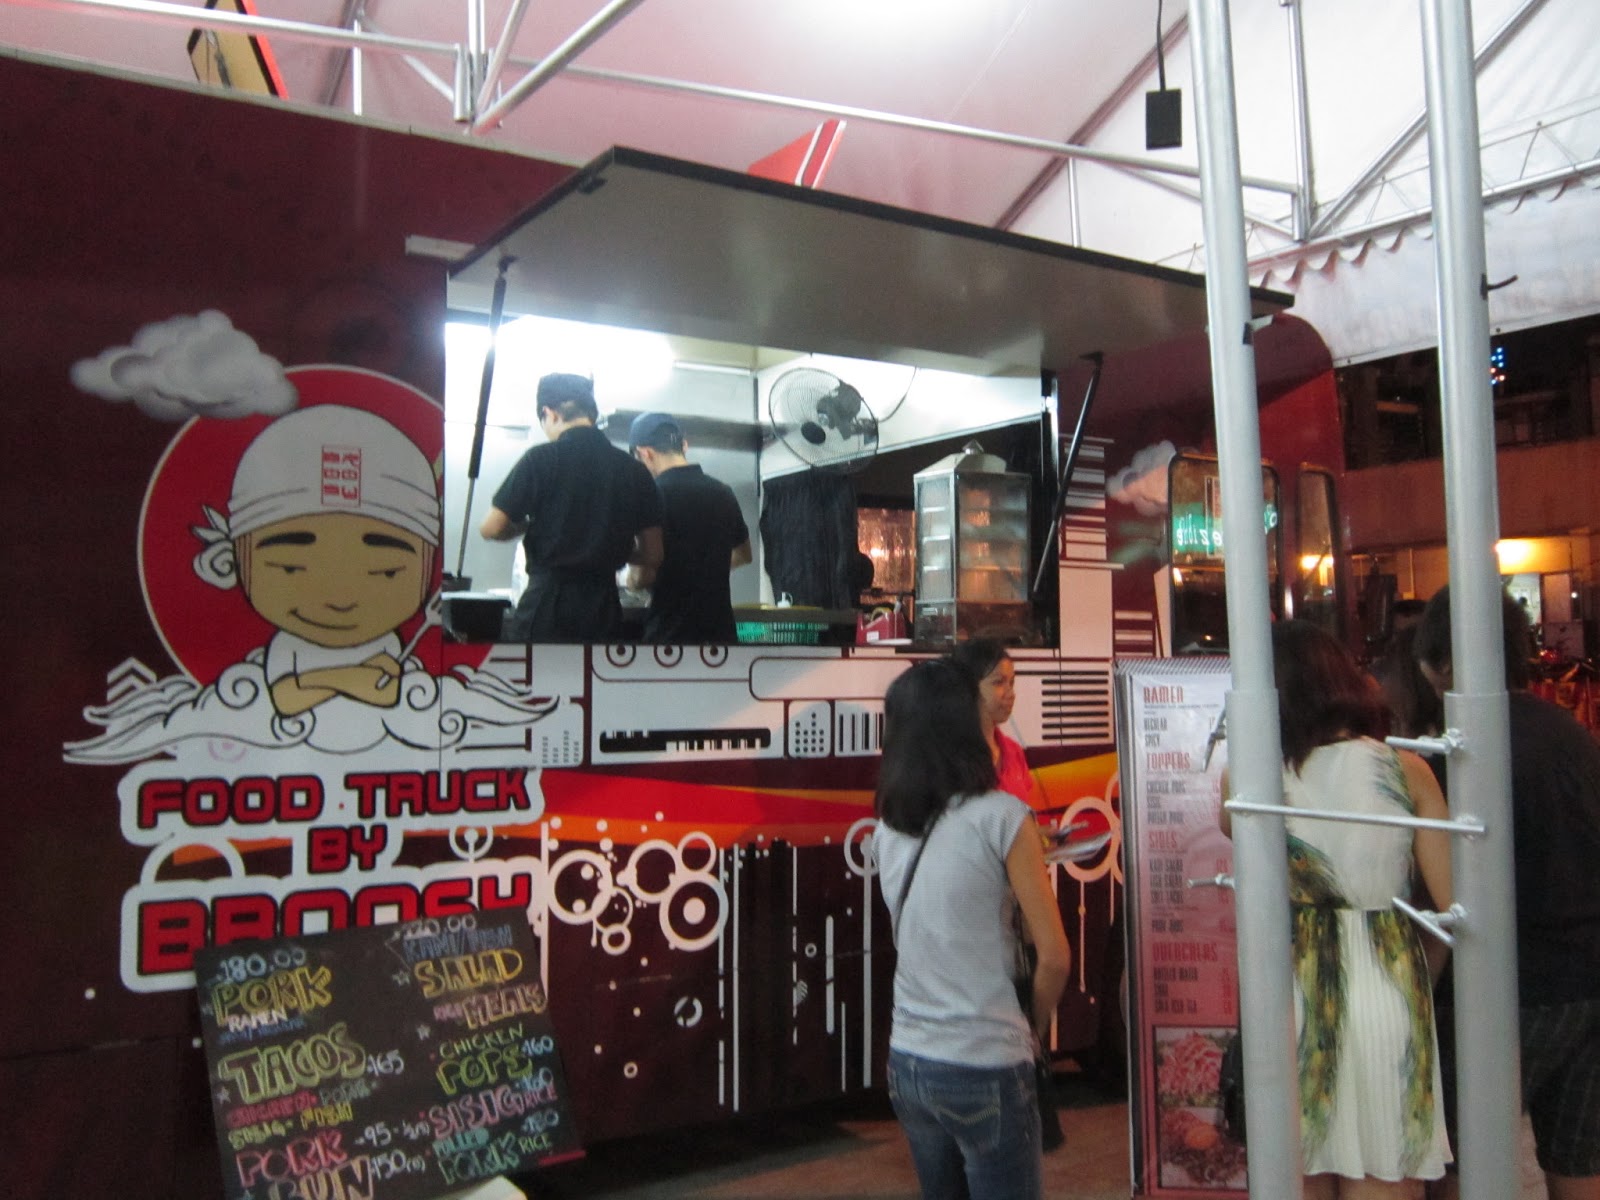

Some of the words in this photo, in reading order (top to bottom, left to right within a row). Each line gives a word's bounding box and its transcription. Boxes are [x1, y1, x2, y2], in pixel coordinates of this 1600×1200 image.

[138, 774, 323, 829] FOOD
[344, 768, 530, 819] TRUCK
[308, 824, 387, 873] BY
[211, 965, 333, 1028] PORK
[217, 1022, 367, 1105] TACOS
[439, 1022, 524, 1060] CHICKEN
[235, 1128, 349, 1188] PORK
[518, 1133, 552, 1153] RICE
